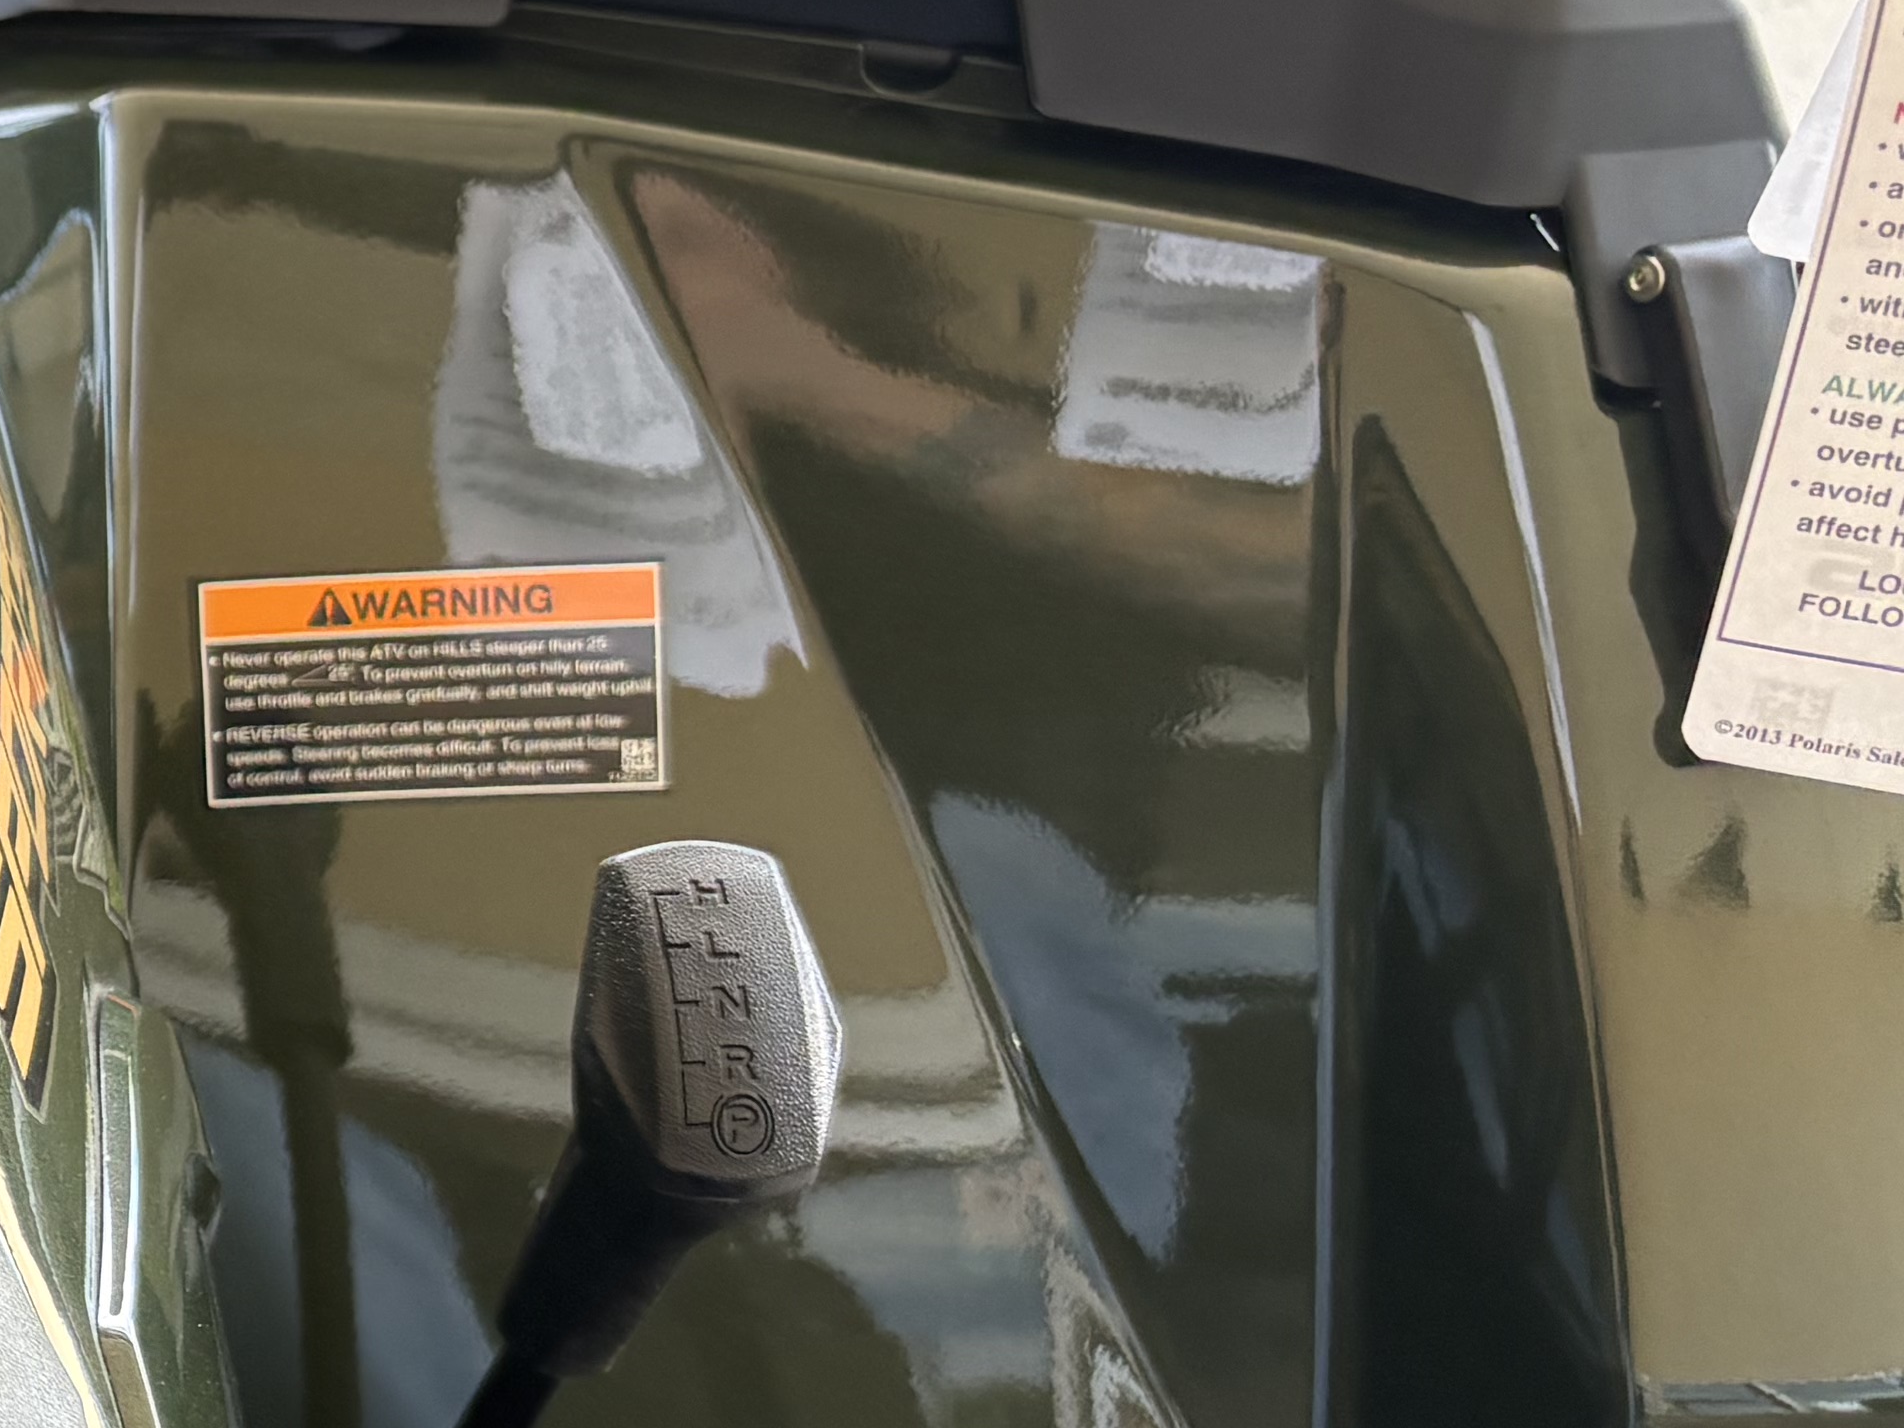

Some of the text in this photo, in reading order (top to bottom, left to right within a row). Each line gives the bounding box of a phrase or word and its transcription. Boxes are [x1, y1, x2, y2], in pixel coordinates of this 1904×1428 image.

[1860, 295, 1904, 318] wit
[1829, 408, 1883, 431] use
[1808, 480, 1892, 508] avoid
[1797, 515, 1881, 545] affect
[352, 584, 554, 621] WARNING
[1788, 733, 1861, 759] Polaris
[689, 878, 729, 905] H
[704, 931, 740, 958] L
[712, 986, 751, 1020] N
[720, 1044, 757, 1080] R
[722, 1103, 760, 1144] P
